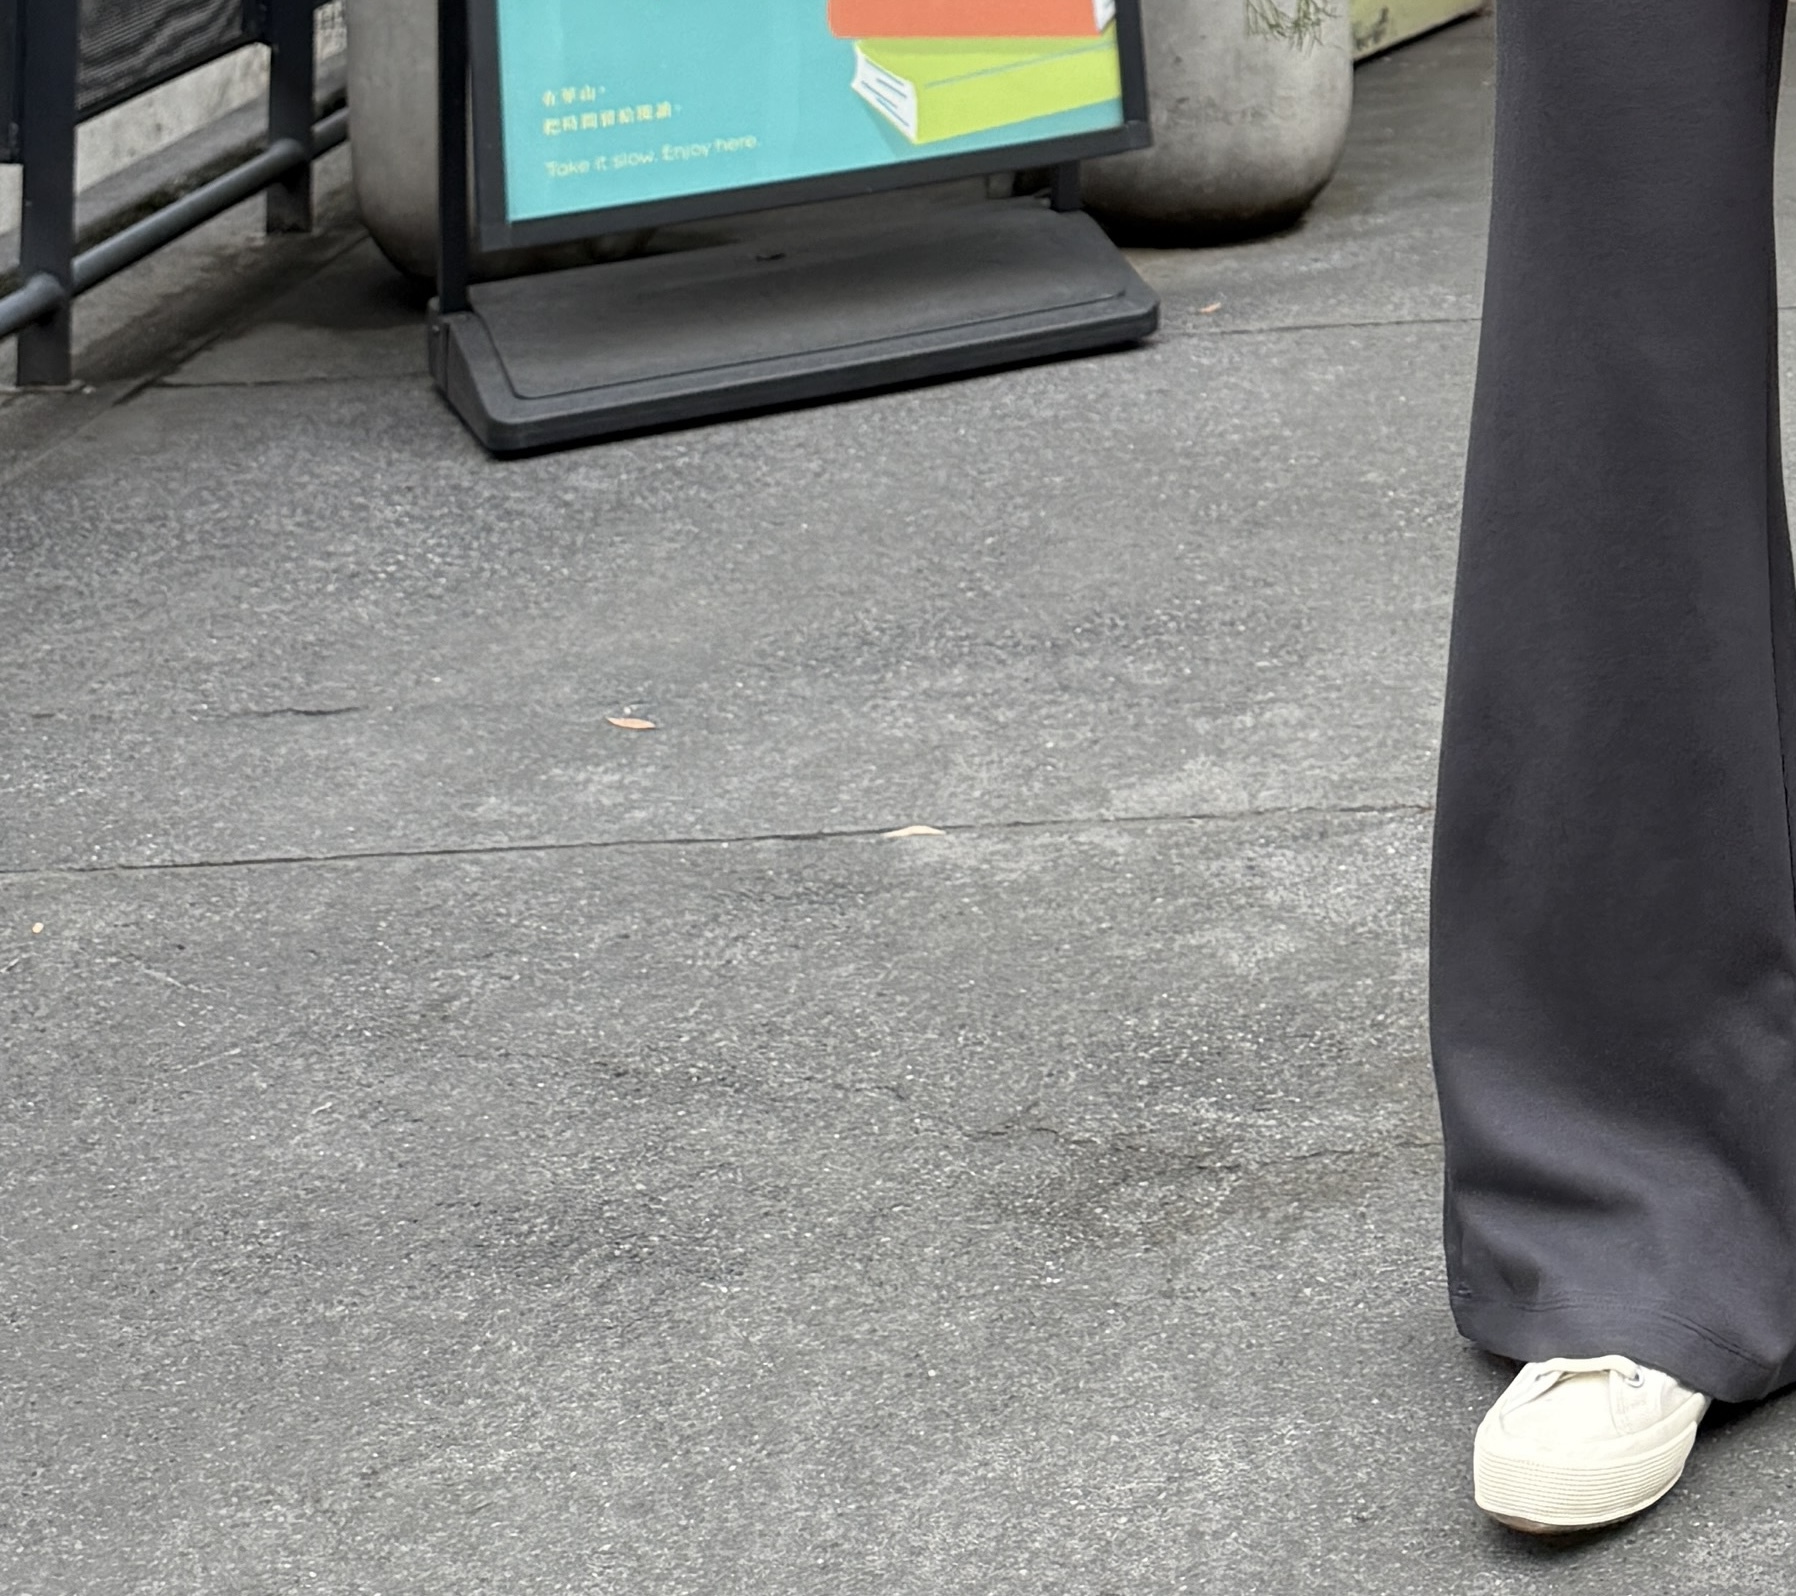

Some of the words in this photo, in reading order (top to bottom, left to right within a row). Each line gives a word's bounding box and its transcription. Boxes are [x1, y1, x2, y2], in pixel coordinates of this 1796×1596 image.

[545, 160, 590, 178] Take
[595, 156, 607, 171] it
[613, 151, 658, 169] slow.
[661, 143, 711, 161] Enjoy
